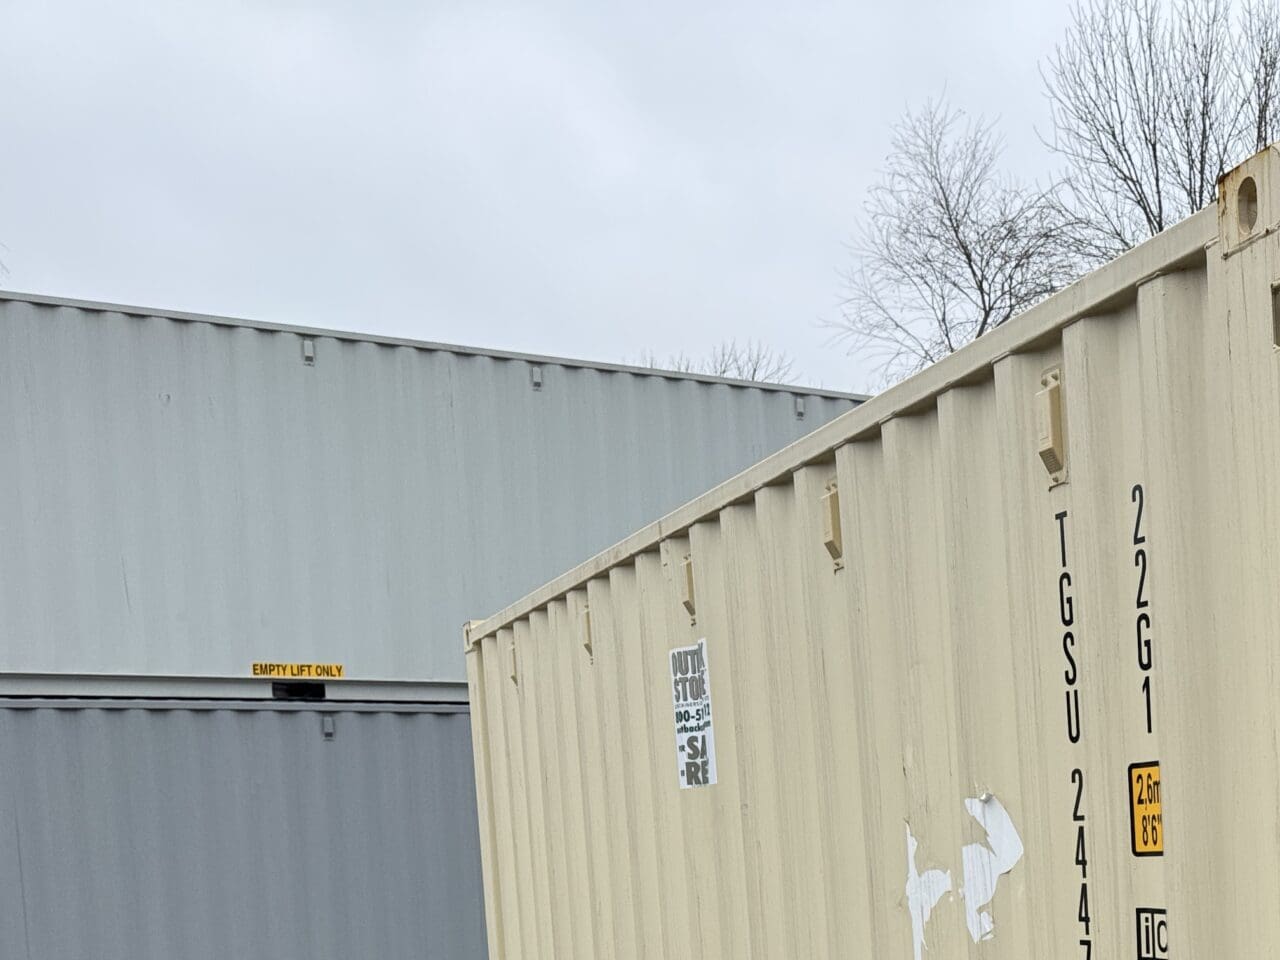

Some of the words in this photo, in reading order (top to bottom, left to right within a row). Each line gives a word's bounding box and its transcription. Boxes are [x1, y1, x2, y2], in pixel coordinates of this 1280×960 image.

[252, 664, 287, 676] EMPTY
[290, 664, 312, 677] LIFT
[315, 665, 343, 677] ONLY
[687, 735, 708, 760] SA
[685, 759, 709, 785] RE
